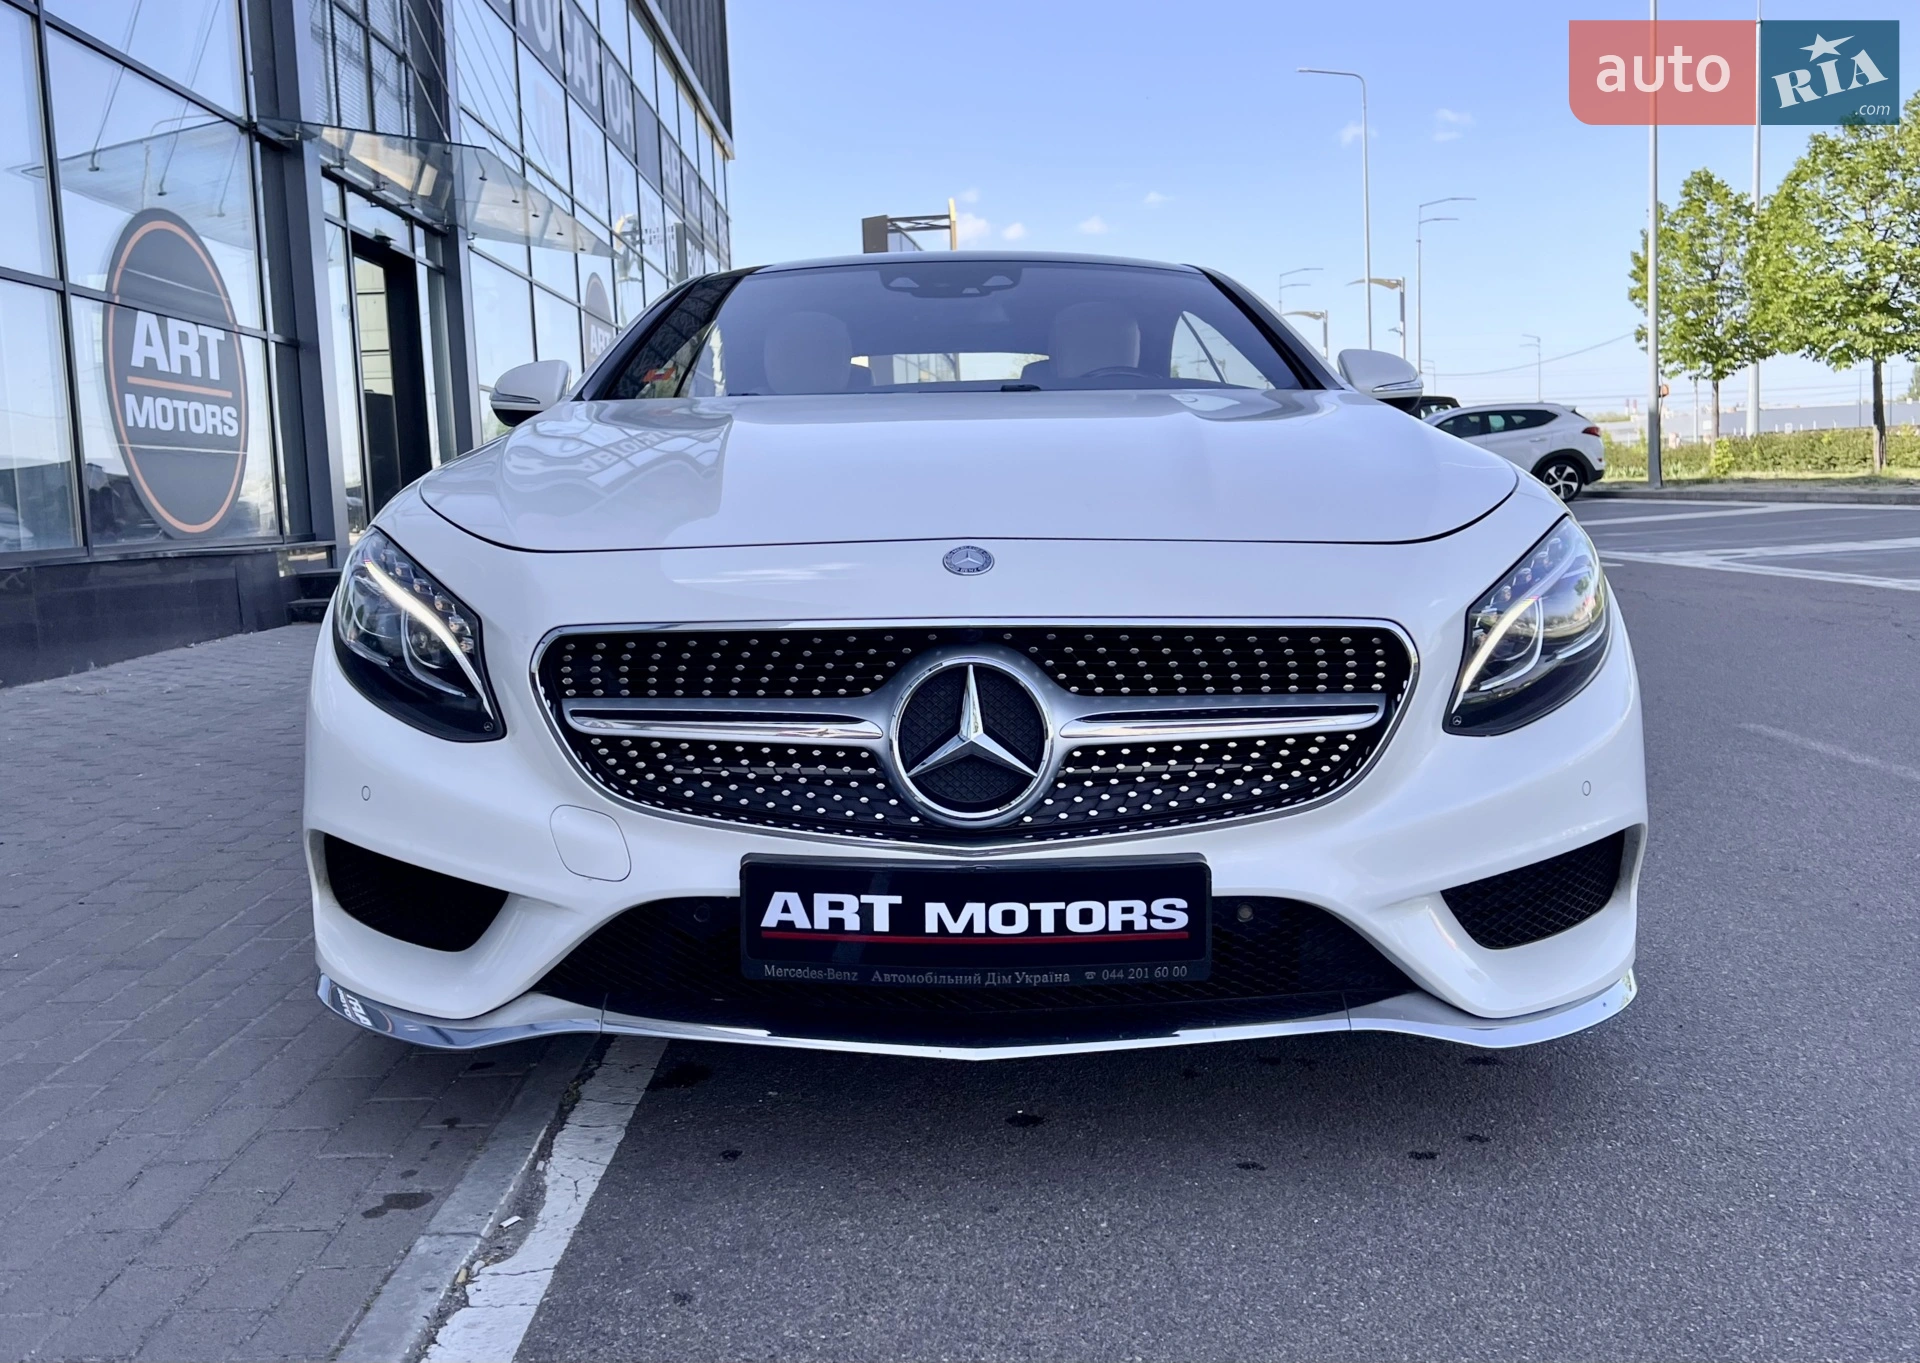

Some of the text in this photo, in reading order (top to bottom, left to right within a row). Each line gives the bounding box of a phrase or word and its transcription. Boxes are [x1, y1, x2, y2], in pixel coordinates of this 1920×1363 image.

[131, 310, 225, 381] ART
[125, 393, 238, 437] MOTORS
[760, 891, 1188, 934] ART MOTORS
[764, 965, 858, 982] Mercedes-Benz
[872, 967, 1071, 986] Автомобільний Дім Україна
[1102, 965, 1188, 981] 044 201 60 00
